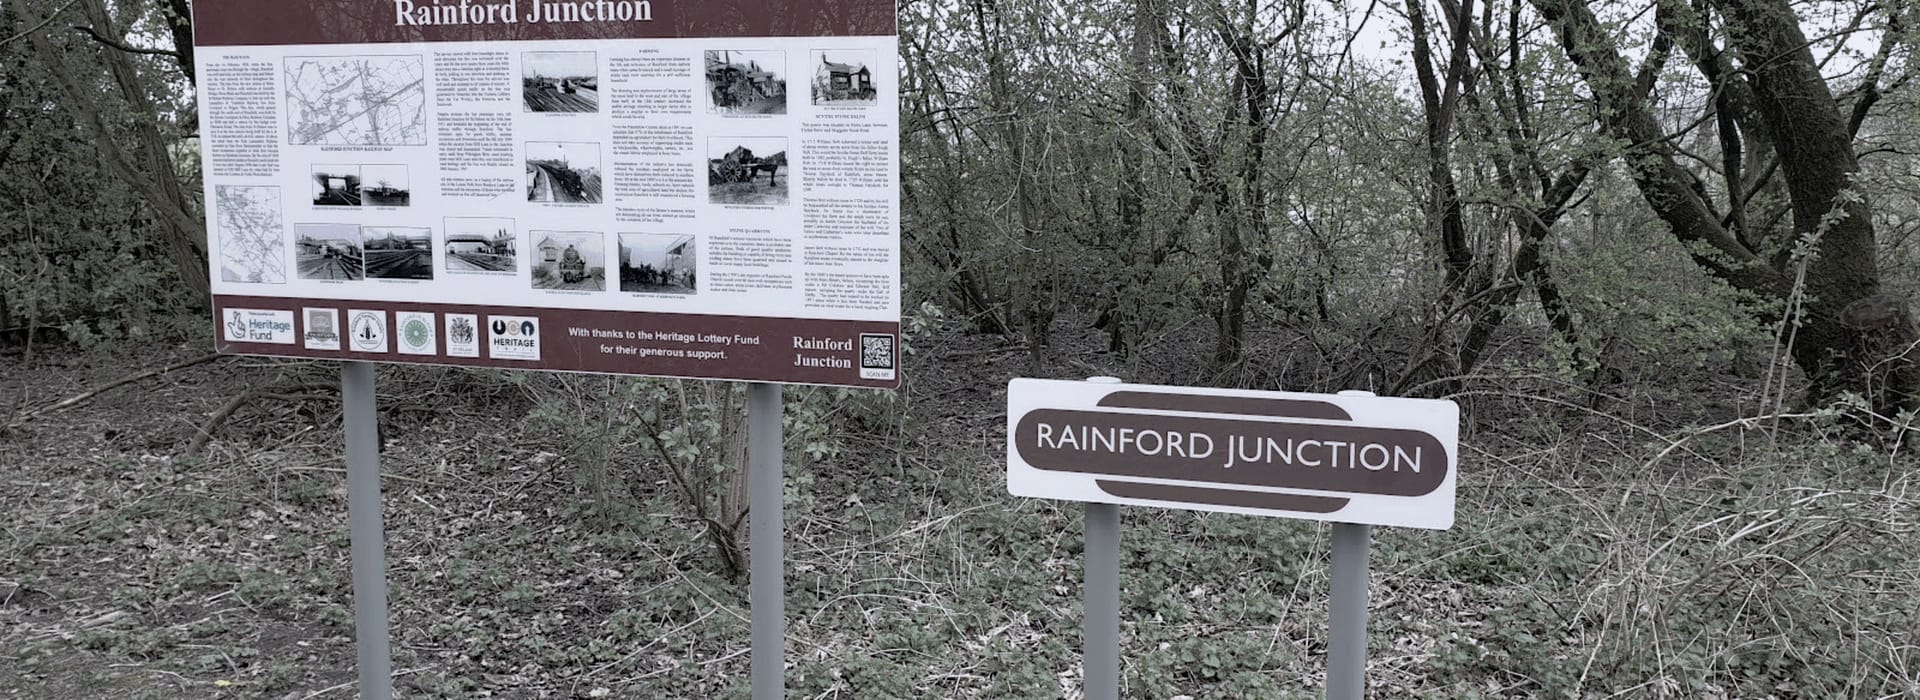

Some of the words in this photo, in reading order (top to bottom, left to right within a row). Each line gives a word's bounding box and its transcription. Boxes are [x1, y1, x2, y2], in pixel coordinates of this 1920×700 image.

[394, 0, 518, 26] Rainford
[526, 0, 653, 24] Junction
[249, 319, 290, 333] Heritage
[250, 330, 272, 340] Fund
[494, 338, 535, 347] HERITAGE
[568, 327, 590, 337] With
[592, 328, 624, 339] thanks
[626, 331, 636, 339] to
[638, 330, 653, 340] the
[655, 331, 695, 343] Heritage
[697, 333, 732, 345] Lottery
[734, 335, 760, 345] Fund
[793, 336, 853, 351] Rainford
[600, 344, 613, 353] for
[616, 345, 638, 355] their
[639, 348, 684, 357] generous
[687, 350, 728, 360] support.
[794, 354, 852, 369] Junction
[1036, 422, 1214, 459] RAINFORD
[1224, 435, 1422, 473] JUNCTION
